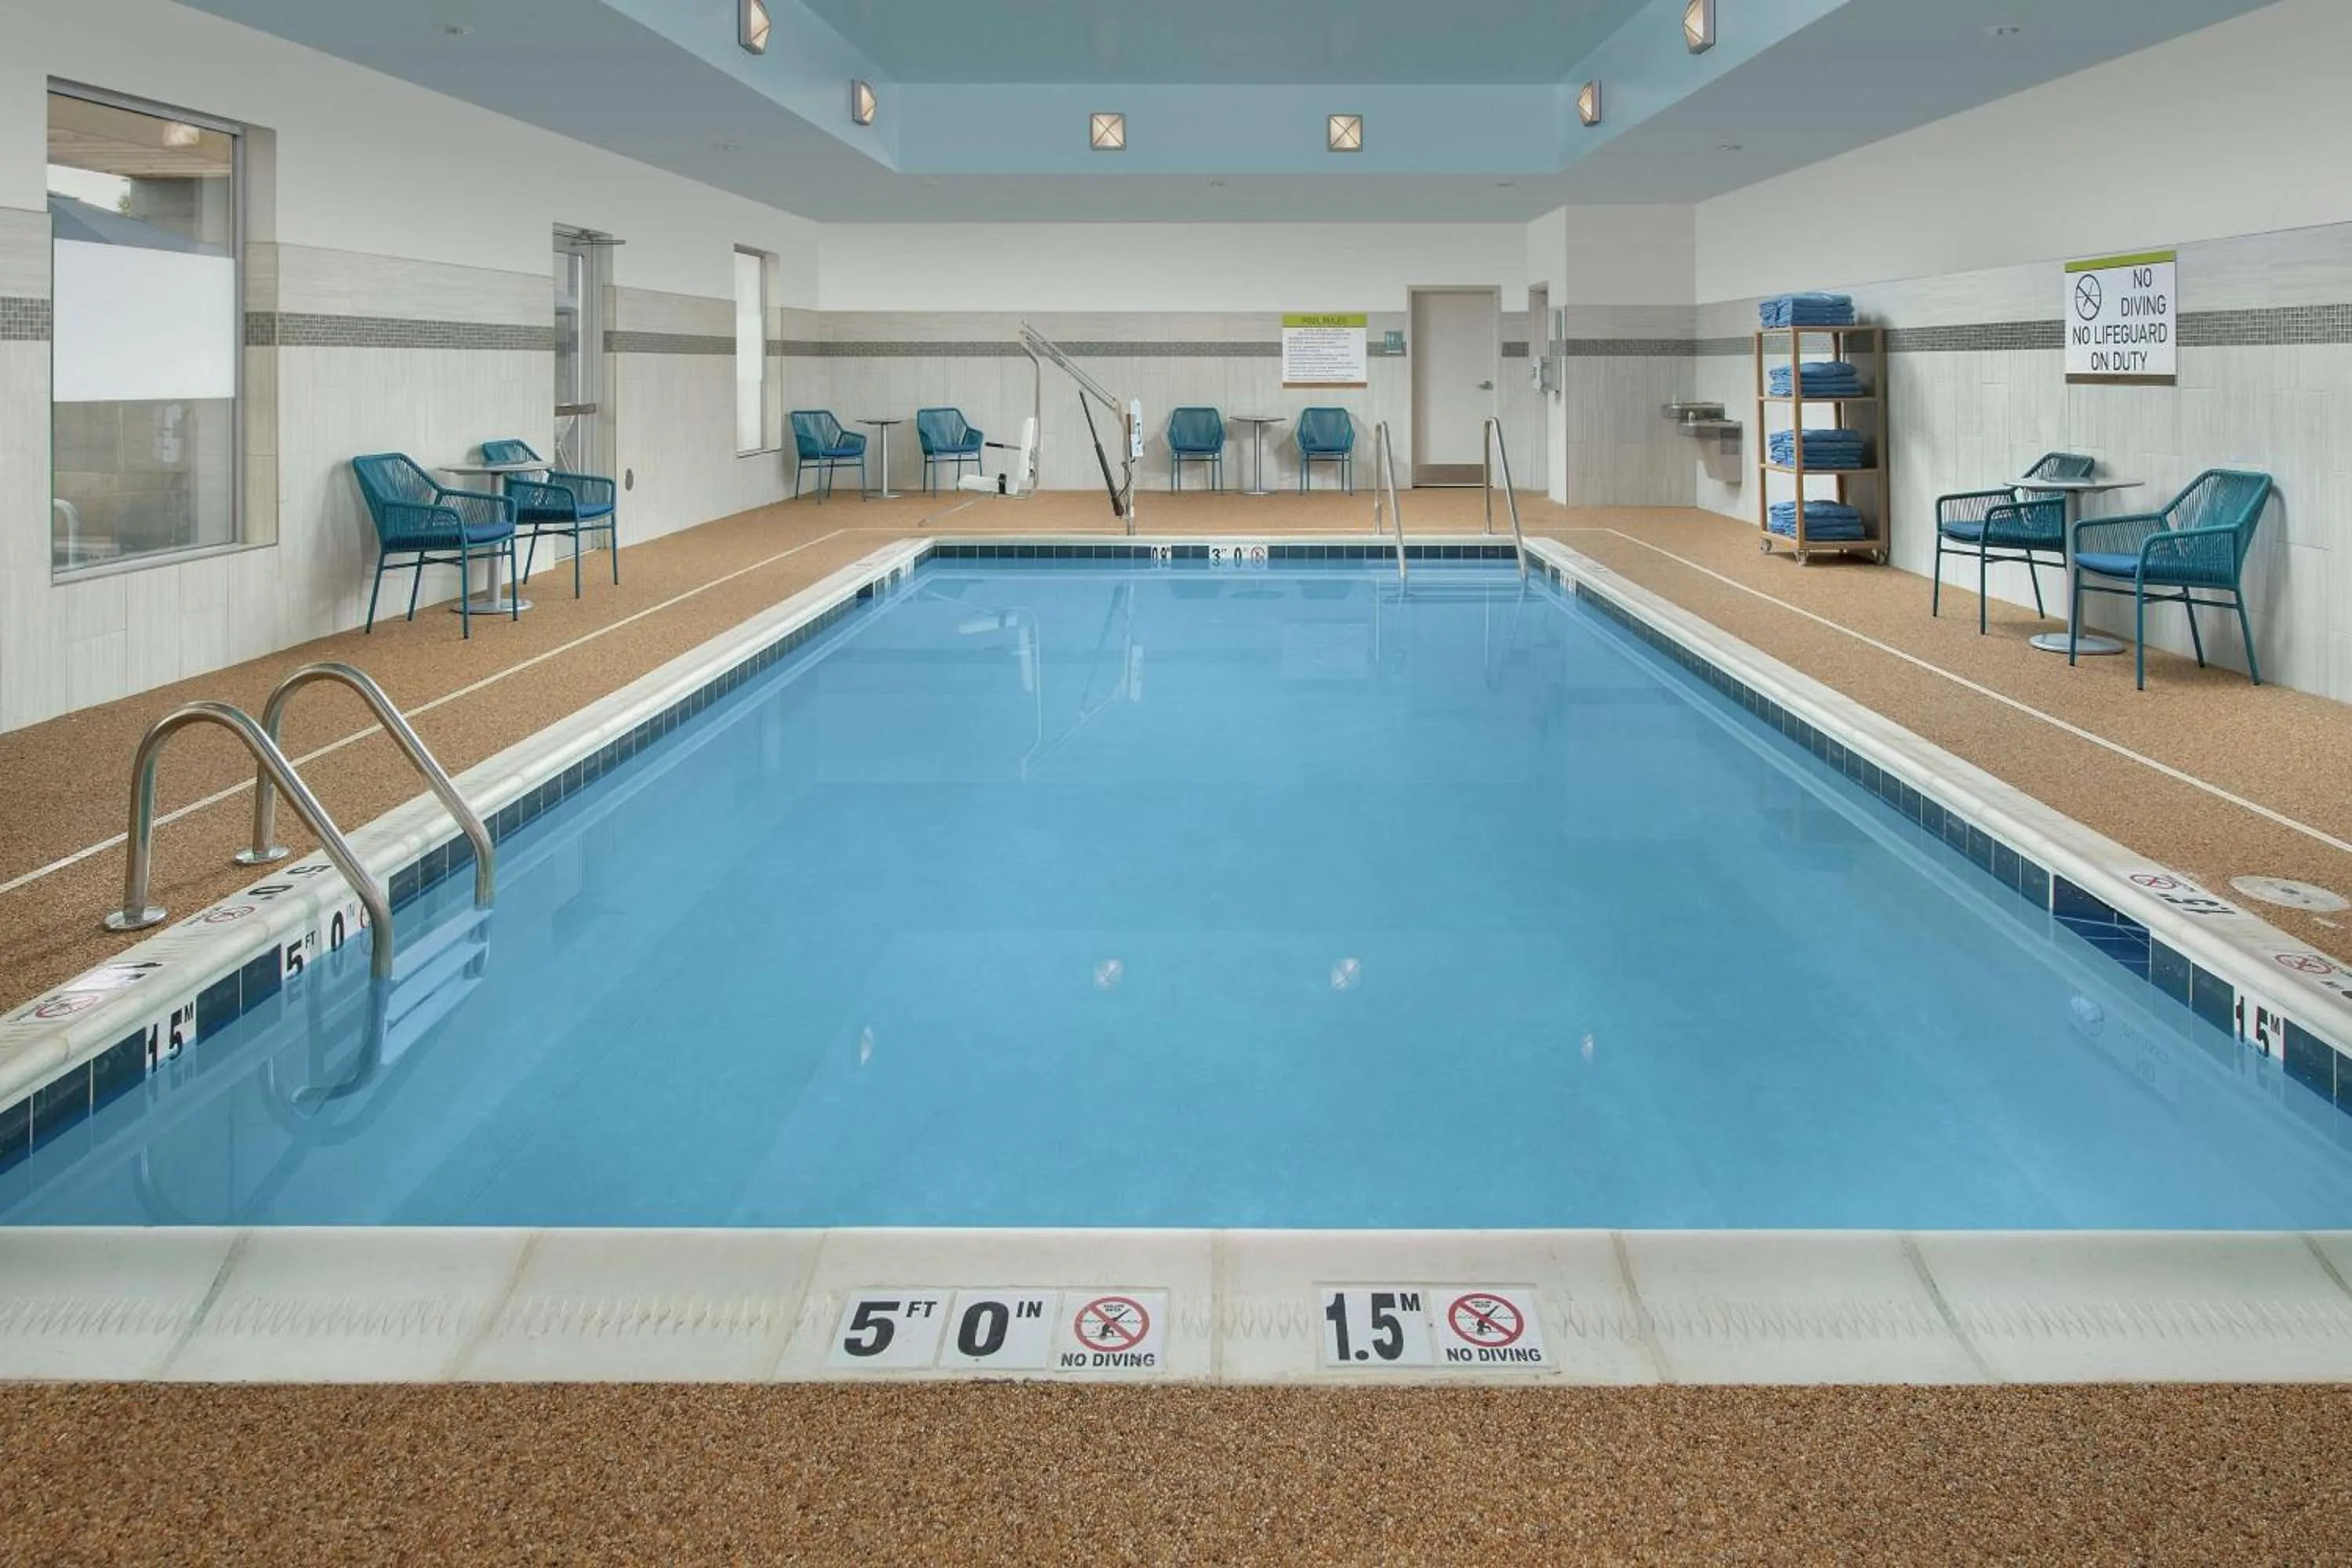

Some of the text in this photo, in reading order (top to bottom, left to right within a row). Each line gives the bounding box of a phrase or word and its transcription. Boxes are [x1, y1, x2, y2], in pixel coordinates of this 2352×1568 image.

[2133, 267, 2152, 289] NO
[2121, 294, 2166, 317] DIVING
[2072, 323, 2168, 345] NO LIFEGUARD
[2091, 351, 2147, 371] ON DUTY
[844, 1301, 1044, 1357] 5 FT 0 IN
[1061, 1352, 1156, 1367] NO DIVING
[1446, 1348, 1542, 1362] NO DIVING
